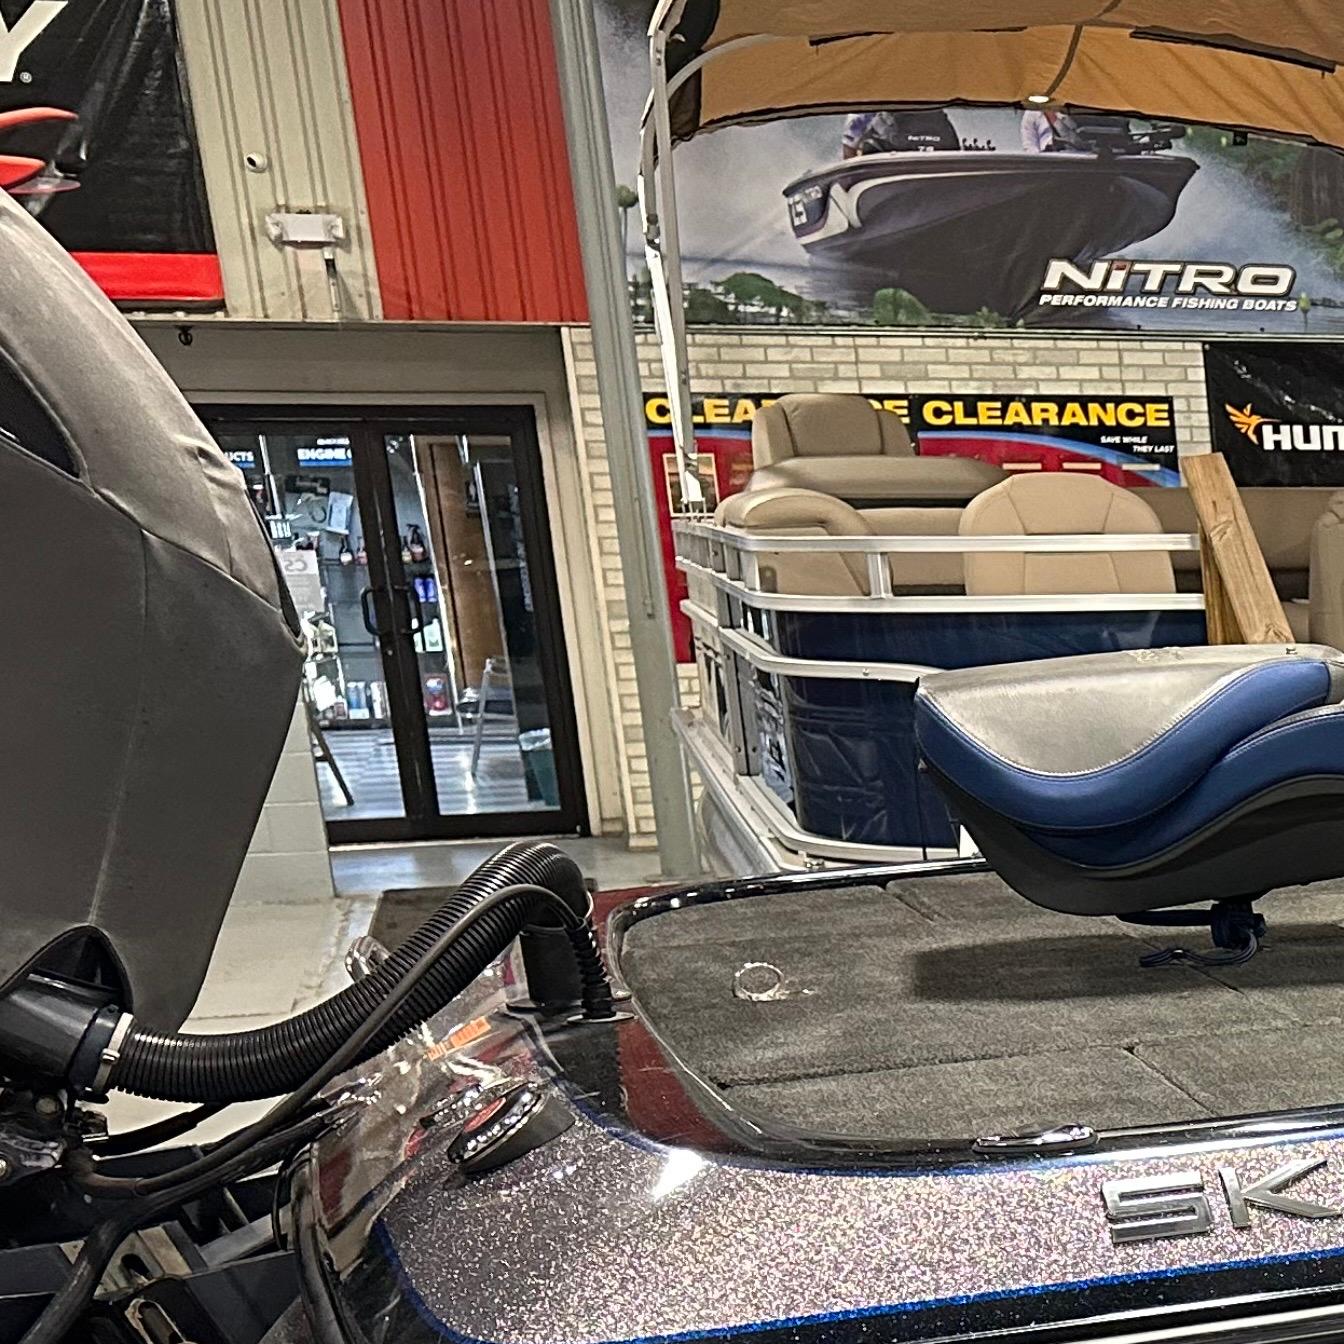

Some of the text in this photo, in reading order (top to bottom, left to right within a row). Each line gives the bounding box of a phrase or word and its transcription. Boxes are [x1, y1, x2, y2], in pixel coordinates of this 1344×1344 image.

[1039, 294, 1298, 312] PERFORMANCE FISHING BOATS
[922, 401, 1171, 427] CLEARANCE
[1133, 445, 1175, 453] THEY LAST
